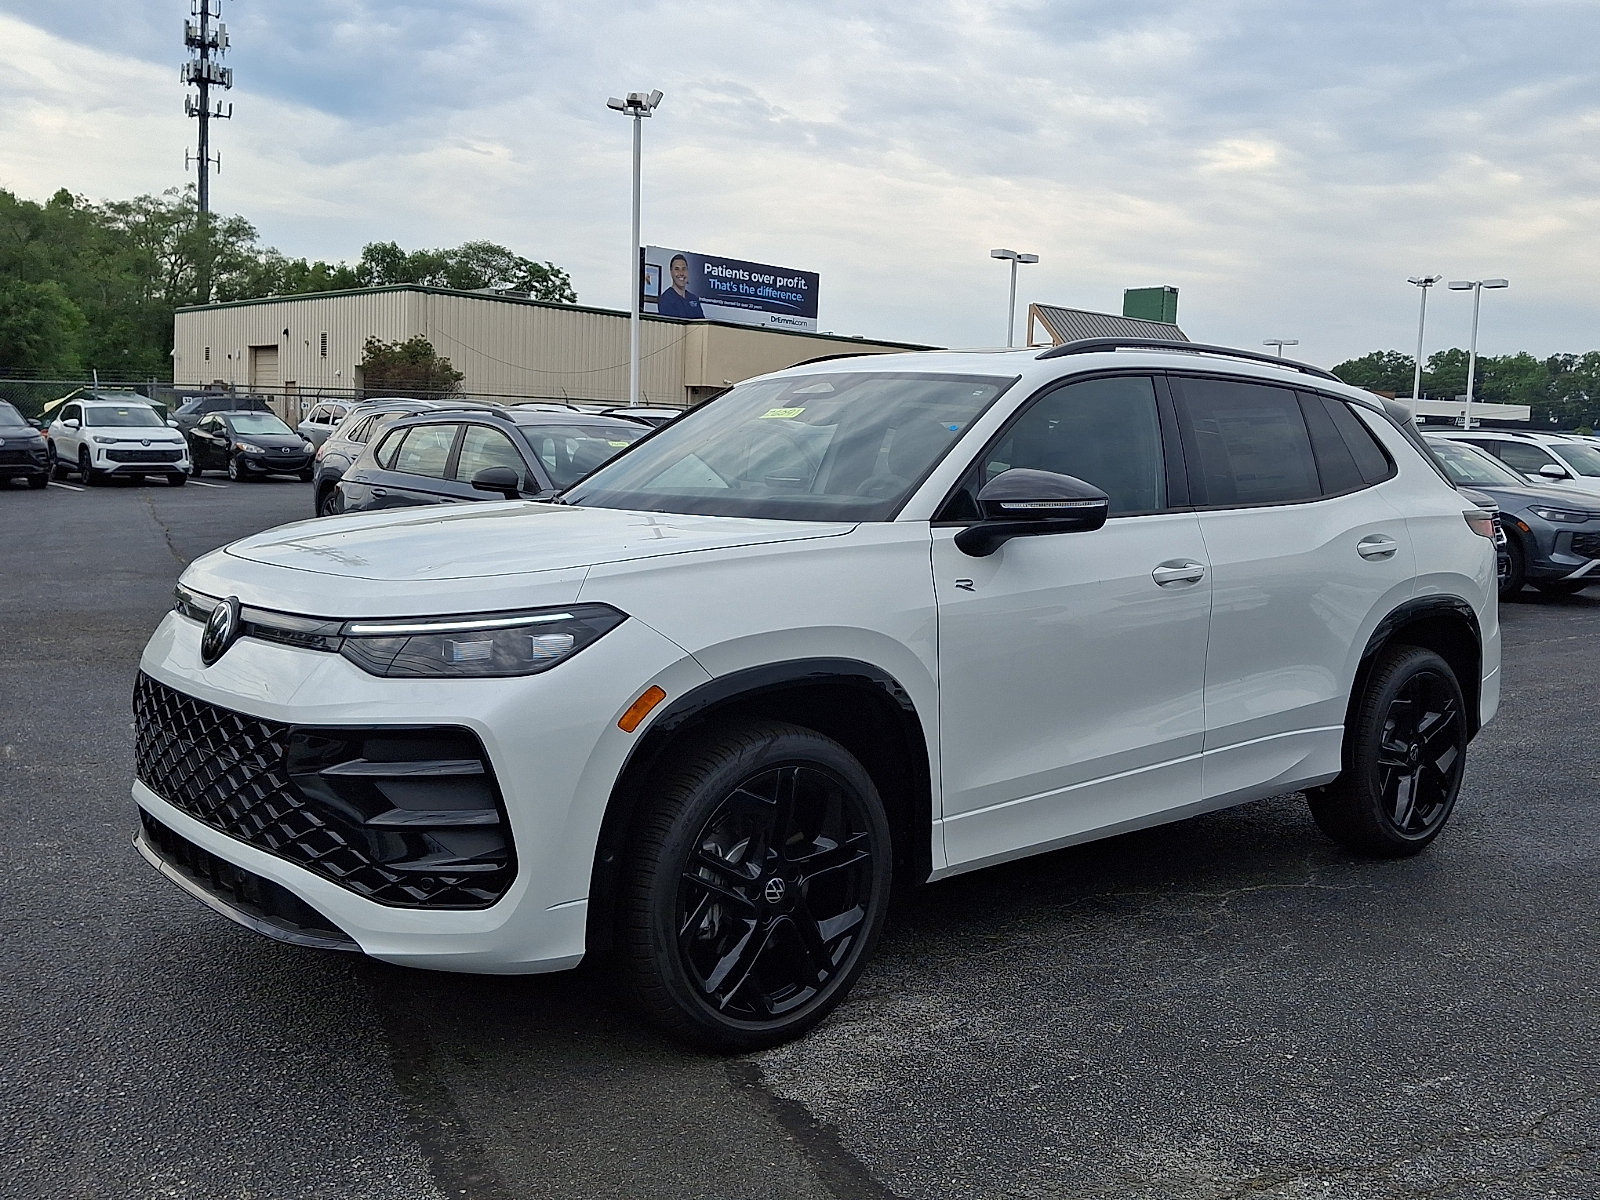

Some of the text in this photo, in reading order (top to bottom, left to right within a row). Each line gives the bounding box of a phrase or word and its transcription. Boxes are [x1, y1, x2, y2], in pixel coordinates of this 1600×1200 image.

[704, 263, 808, 290] Patients over profit.
[708, 278, 805, 302] That's the difference.
[770, 315, 808, 327] DrEmmi.com
